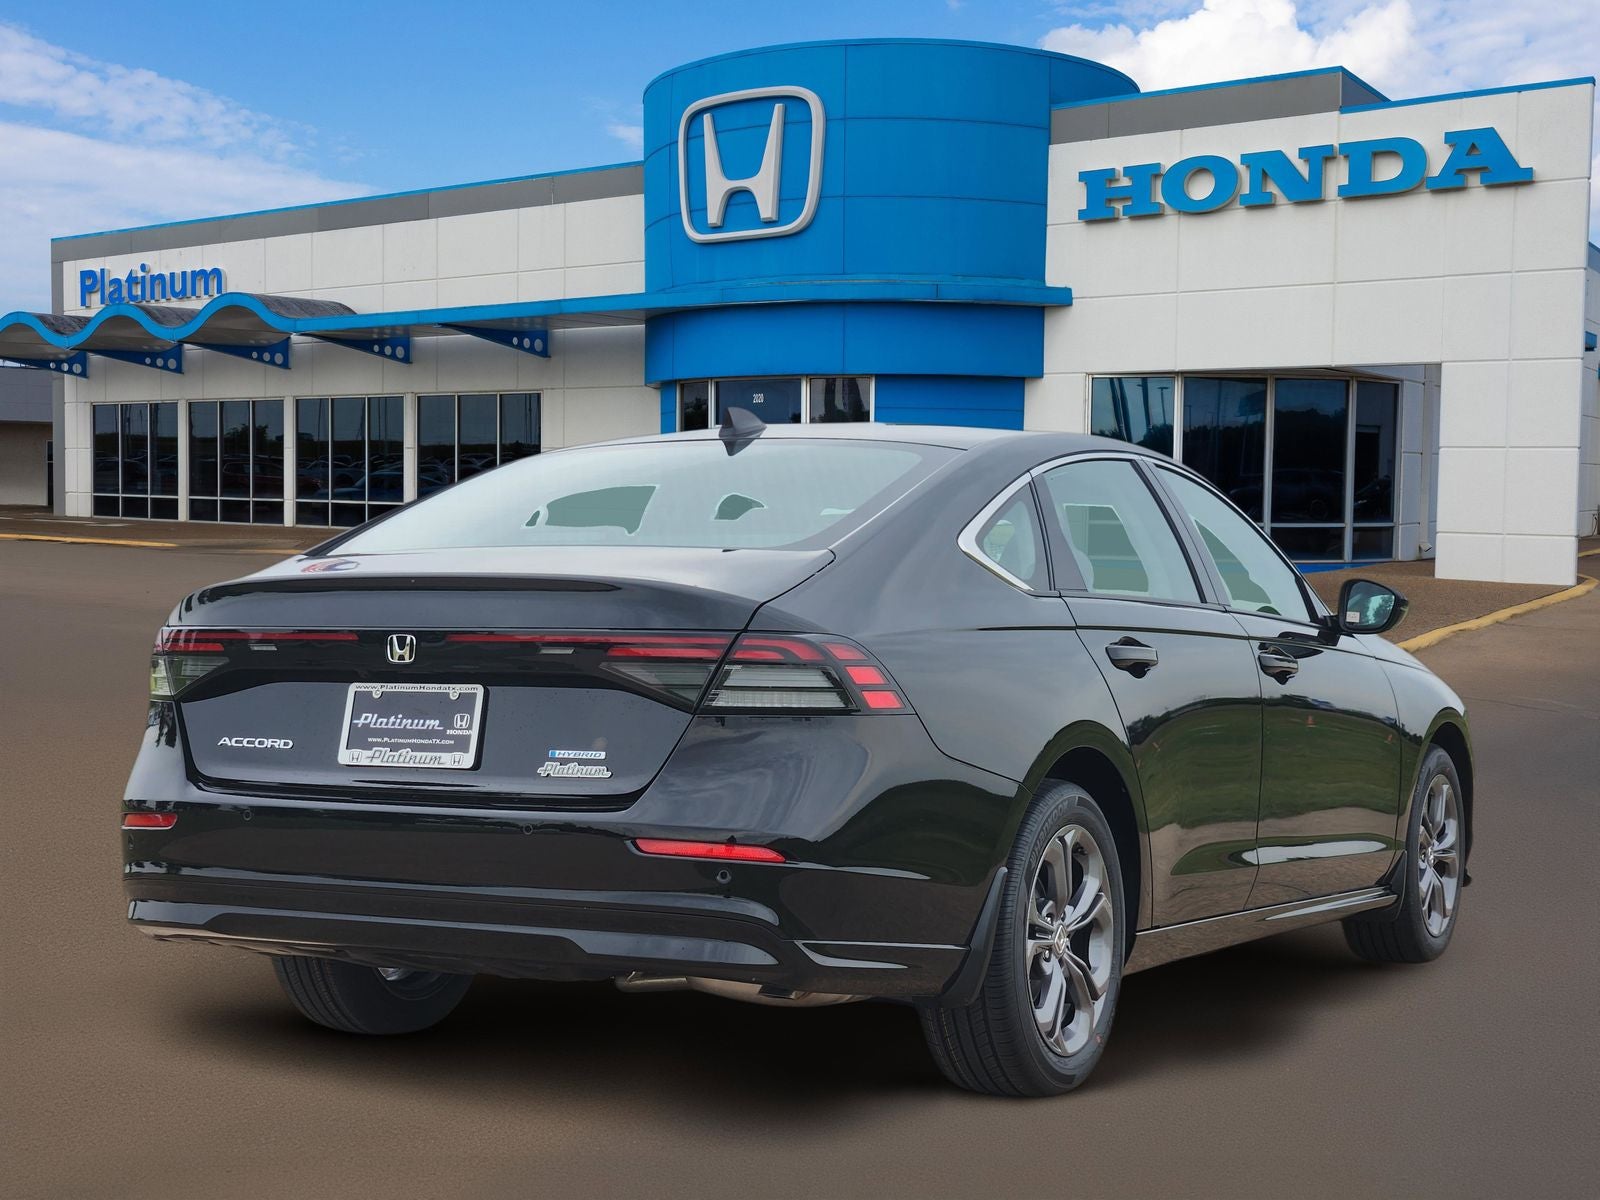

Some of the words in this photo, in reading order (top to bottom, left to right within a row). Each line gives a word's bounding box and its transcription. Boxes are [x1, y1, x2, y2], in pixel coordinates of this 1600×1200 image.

[1078, 127, 1534, 222] HONDA
[80, 263, 224, 307] Platinum
[352, 713, 444, 730] Platinum
[217, 736, 294, 749] ACCORD
[364, 748, 446, 766] Platinum
[538, 762, 612, 778] Platinum
